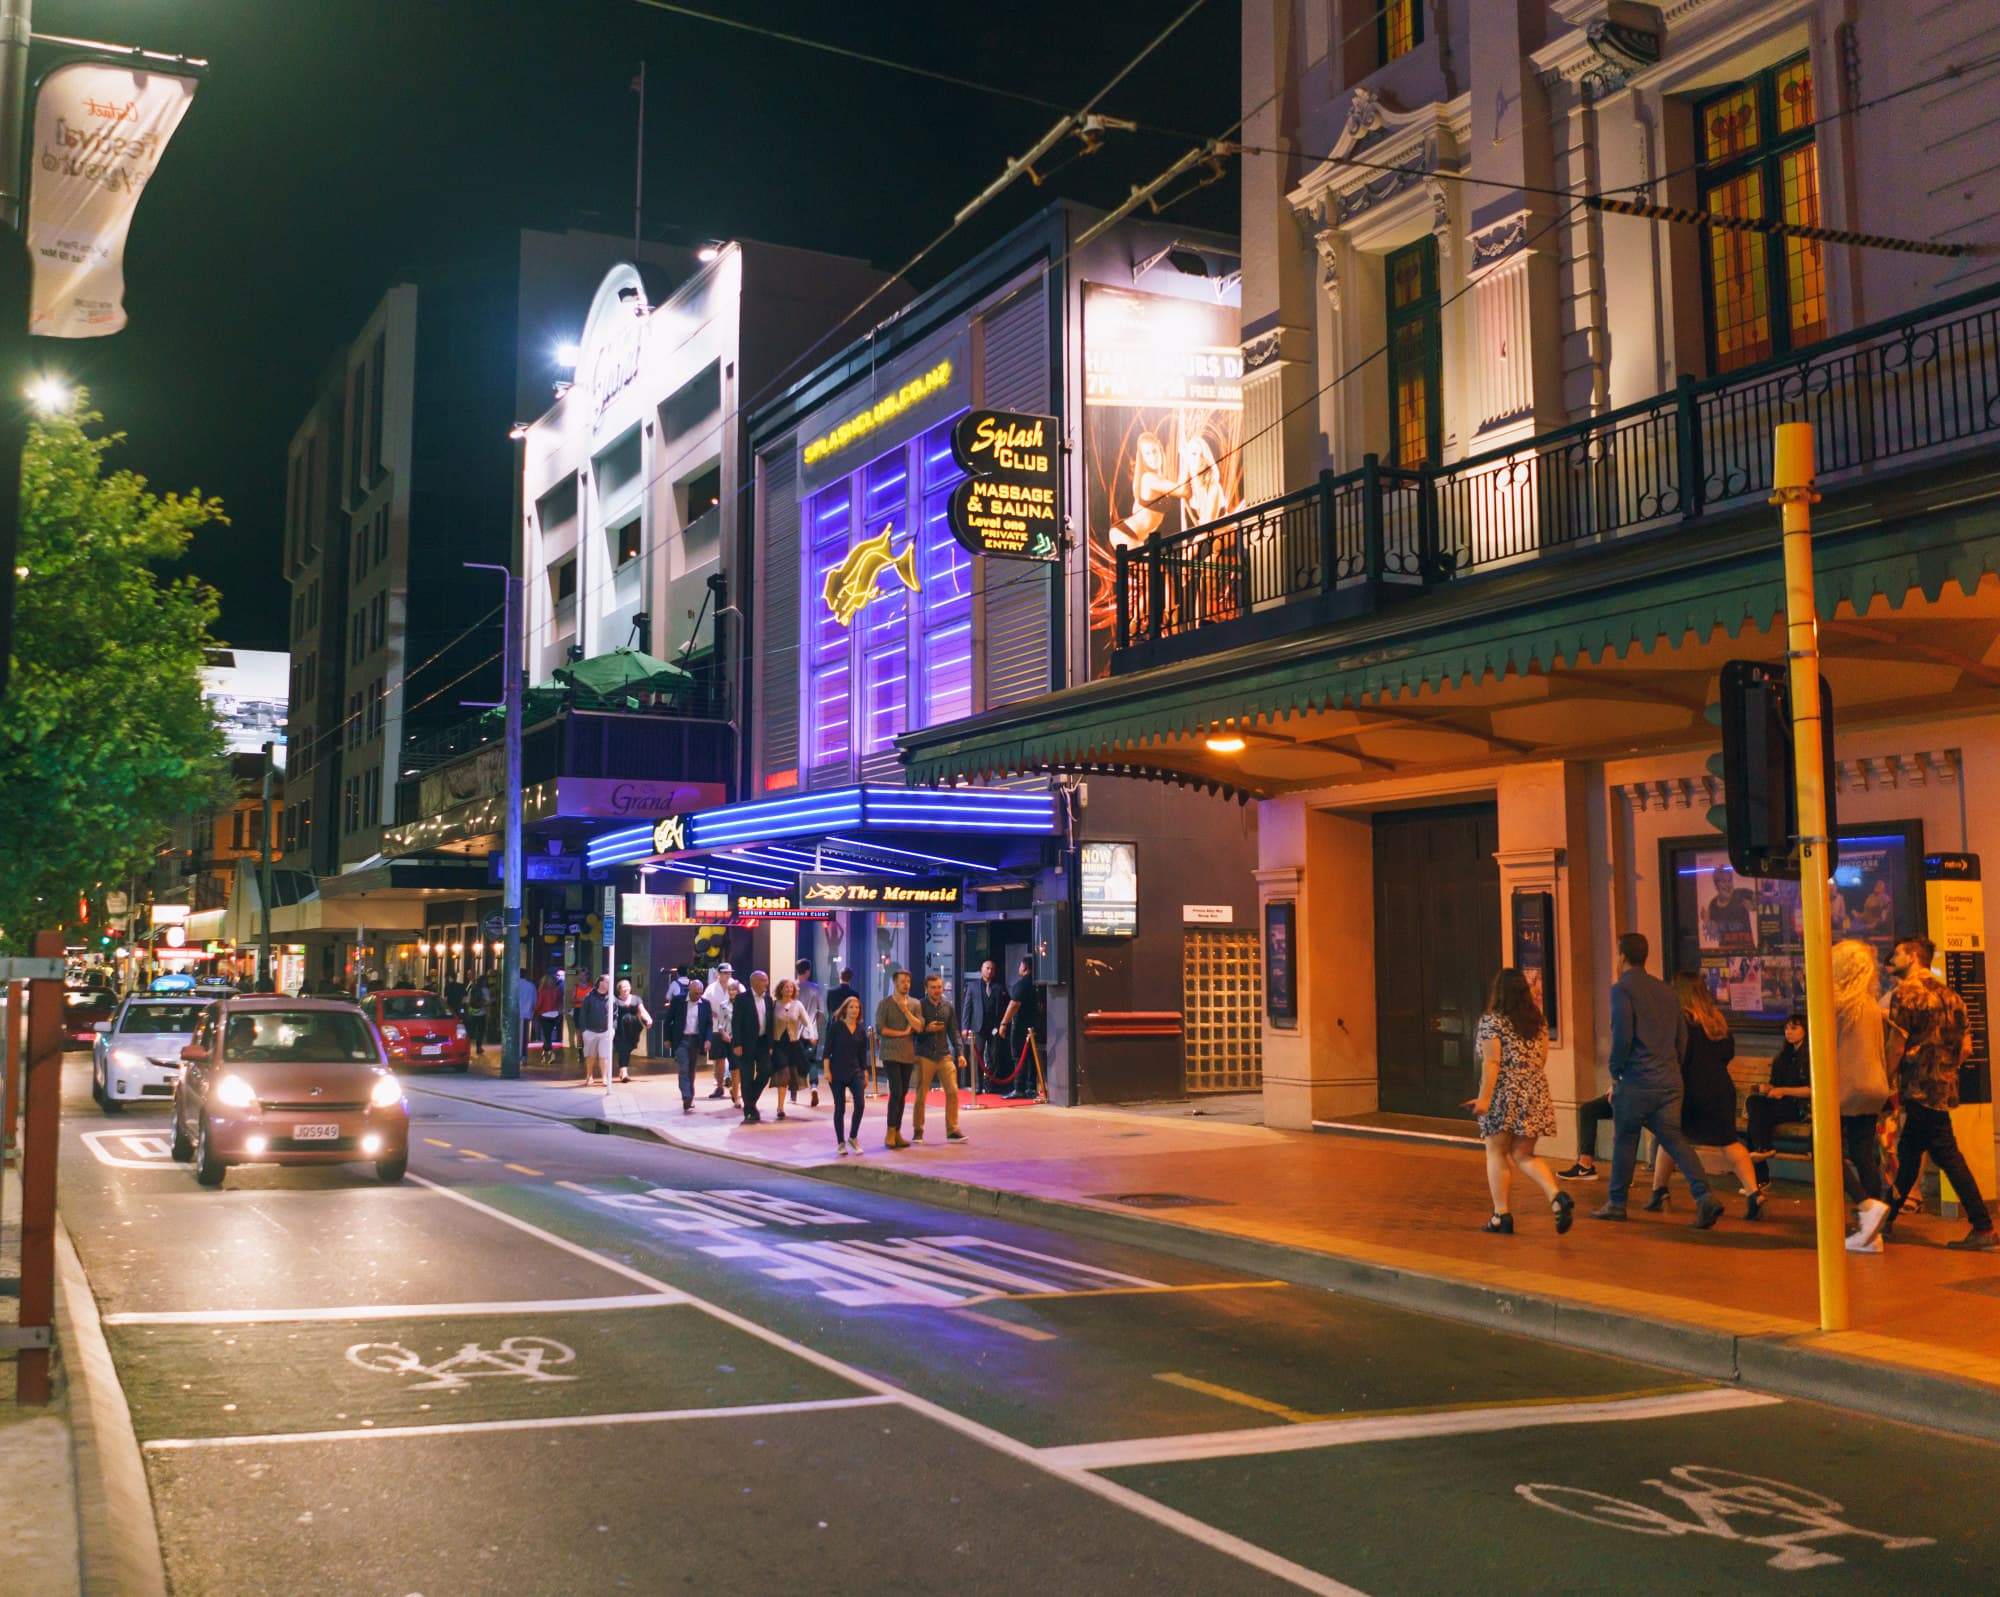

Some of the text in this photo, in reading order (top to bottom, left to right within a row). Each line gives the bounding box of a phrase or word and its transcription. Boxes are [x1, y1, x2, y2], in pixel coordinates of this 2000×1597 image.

[1190, 384, 1216, 398] FREE
[804, 361, 951, 463] SPLASHCLUB.CO.NZ
[970, 417, 1044, 458] Splash
[1000, 449, 1048, 472] CLUB
[973, 482, 1054, 504] MASSAGE
[967, 496, 1055, 520] & SAUNA
[968, 514, 1026, 531] Level one
[981, 528, 1028, 541] PRIVATE
[985, 539, 1024, 551] ENTRY
[611, 783, 675, 815] Grand
[1082, 848, 1112, 864] NOW
[1804, 845, 1812, 858] 6
[848, 886, 957, 901] The Mermaid
[738, 896, 791, 910] Splash
